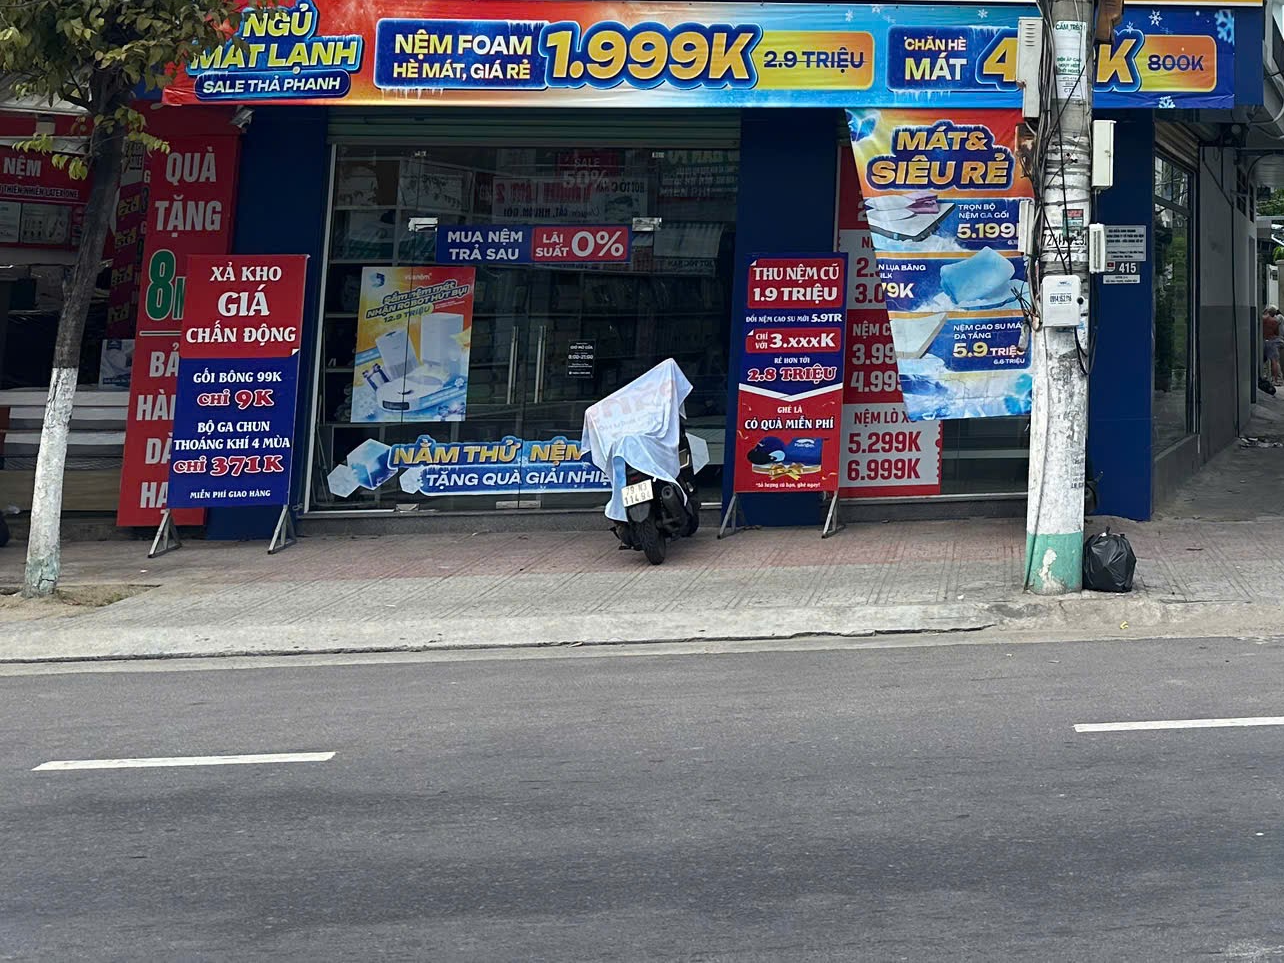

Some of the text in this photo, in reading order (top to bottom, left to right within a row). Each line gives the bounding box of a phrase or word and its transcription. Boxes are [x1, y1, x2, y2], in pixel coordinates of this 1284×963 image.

[243, 3, 312, 37] NGỦ
[395, 29, 532, 60] NỆM FOAM
[904, 36, 966, 51] CHĂN HÈ
[268, 41, 357, 75] LẠNH
[546, 30, 754, 79] 1.999K
[764, 46, 864, 73] 2.9 TRIỆU
[1148, 54, 1204, 72] 800K
[393, 59, 531, 80] HÈ MÁT, GIÁ RẺ
[905, 51, 967, 81] MÁT
[203, 75, 340, 94] SALE THẢ PHANH
[3, 155, 42, 179] NỆM
[166, 146, 217, 185] QUÀ
[871, 153, 1009, 185] SIÊU RẺ
[155, 194, 222, 237] TẶNG
[959, 211, 978, 220] NỆM
[983, 203, 995, 211] BỘ
[447, 229, 522, 247] MUA NỆM
[543, 233, 563, 244] LÃI
[571, 231, 624, 257] 0%
[449, 244, 519, 261] TRẢ SAU
[535, 243, 569, 257] SUẤT
[210, 261, 282, 282] XẢ KHO
[753, 267, 784, 280] THU
[786, 264, 818, 283] NỆM
[820, 263, 839, 280] CŨ
[901, 263, 926, 271] BĂNG
[1119, 263, 1136, 273] 415
[217, 284, 270, 317] GIÁ
[367, 305, 396, 318] NHẬN
[397, 296, 431, 310] ROBOT
[430, 290, 451, 301] HÚT
[451, 286, 468, 297] BỤI
[753, 283, 837, 304] 1.9 TRIỆU
[759, 315, 772, 323] NỆM
[811, 313, 842, 322] 5.9TR
[953, 324, 973, 332] NỆM
[186, 320, 296, 347] CHẤN ĐỘNG
[852, 320, 879, 339] NỆM
[968, 332, 991, 340] TẦNG
[953, 342, 988, 358] 5.9
[193, 367, 282, 383] GỐI BÔNG 99K
[747, 363, 837, 384] 2.8 TRIỆU
[777, 405, 792, 413] GHÉ
[854, 408, 899, 427] NỆM LÒ
[197, 419, 270, 433] BỘ GA CHUN
[745, 416, 834, 430] CÓ QUÀ MIỄN PHÍ
[174, 435, 290, 451] THOÁNG KHÍ 4 MÙA
[393, 438, 460, 465] NẰM
[464, 439, 521, 463] THỬ
[848, 431, 921, 454] 5.299K
[210, 455, 284, 477] 371K
[847, 458, 921, 481] 6.999K
[426, 466, 563, 489] TẶNG QUÀ GIẢI
[190, 487, 270, 499] MIỄN PHÍ GIAO HÀNG
